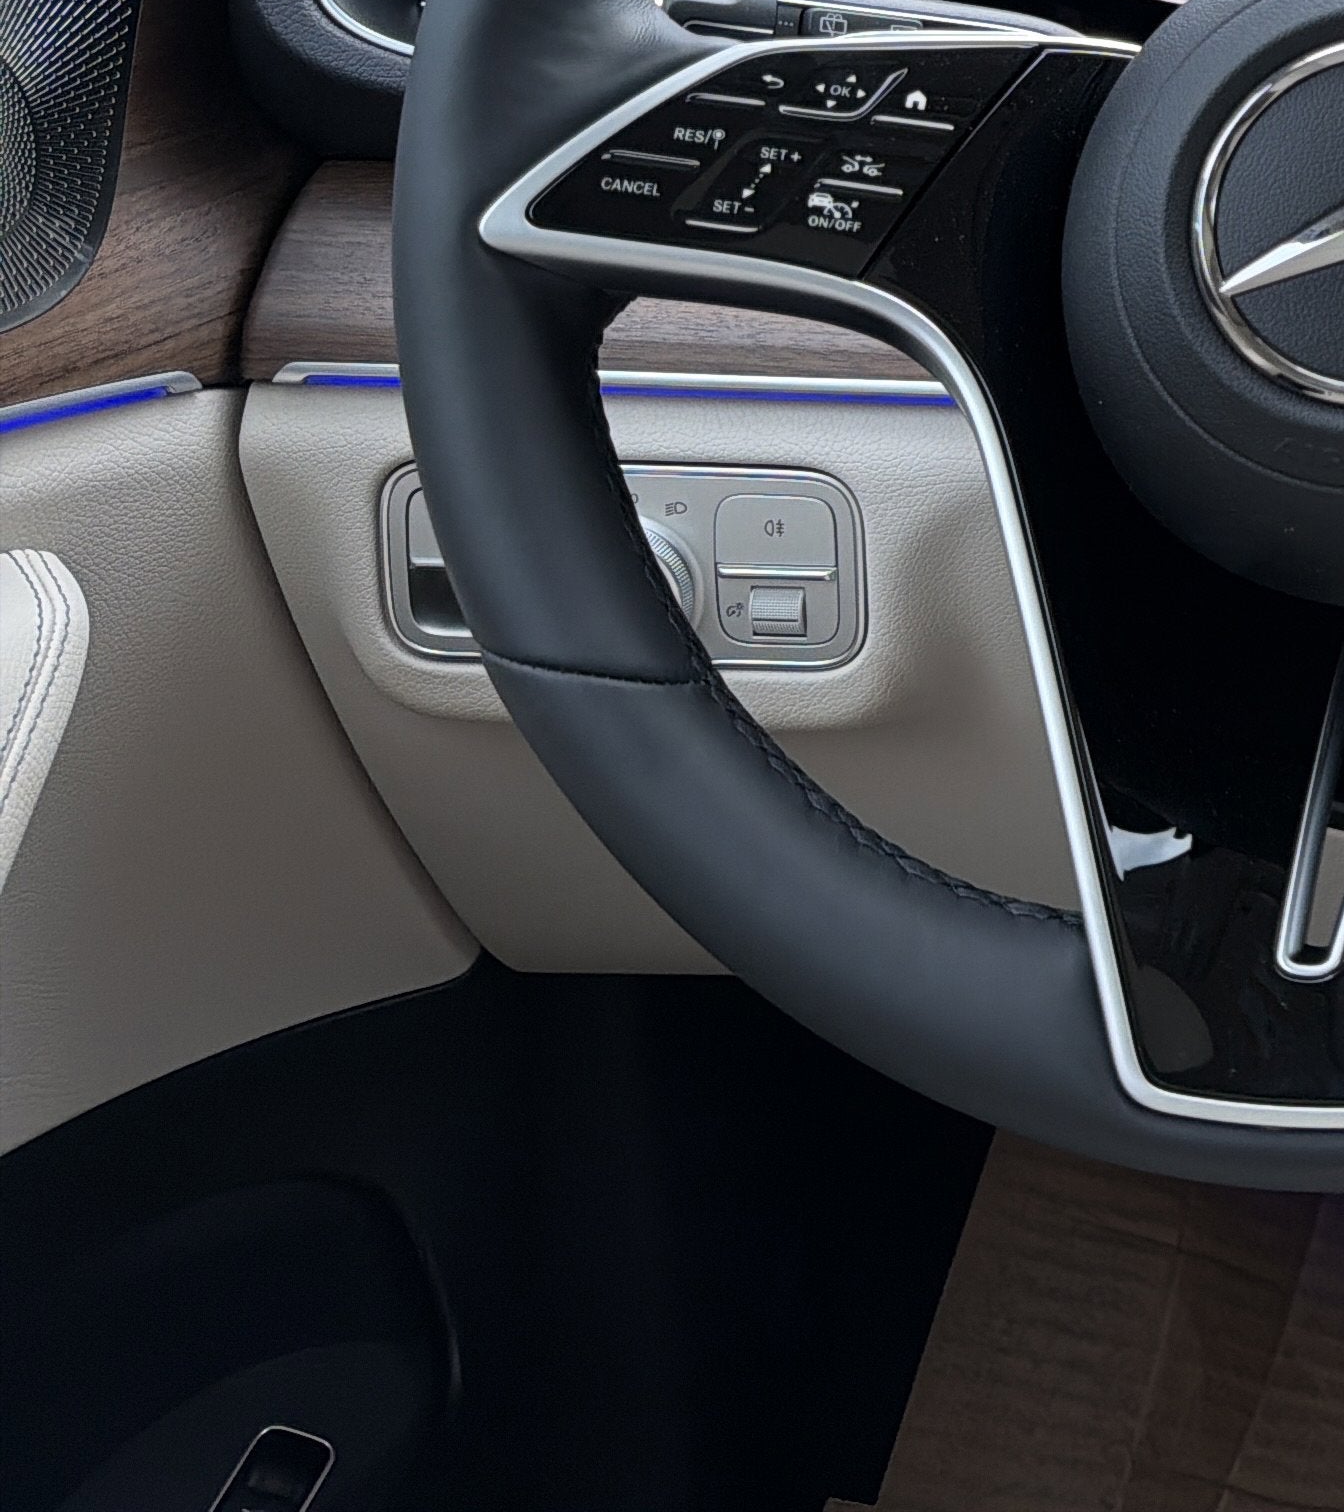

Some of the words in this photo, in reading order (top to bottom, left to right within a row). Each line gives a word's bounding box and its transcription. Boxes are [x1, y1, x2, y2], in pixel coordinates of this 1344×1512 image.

[830, 84, 852, 98] OK
[760, 146, 789, 162] SET
[600, 176, 661, 198] CANCEL
[712, 198, 740, 214] SET
[807, 215, 862, 234] ON/OFF
